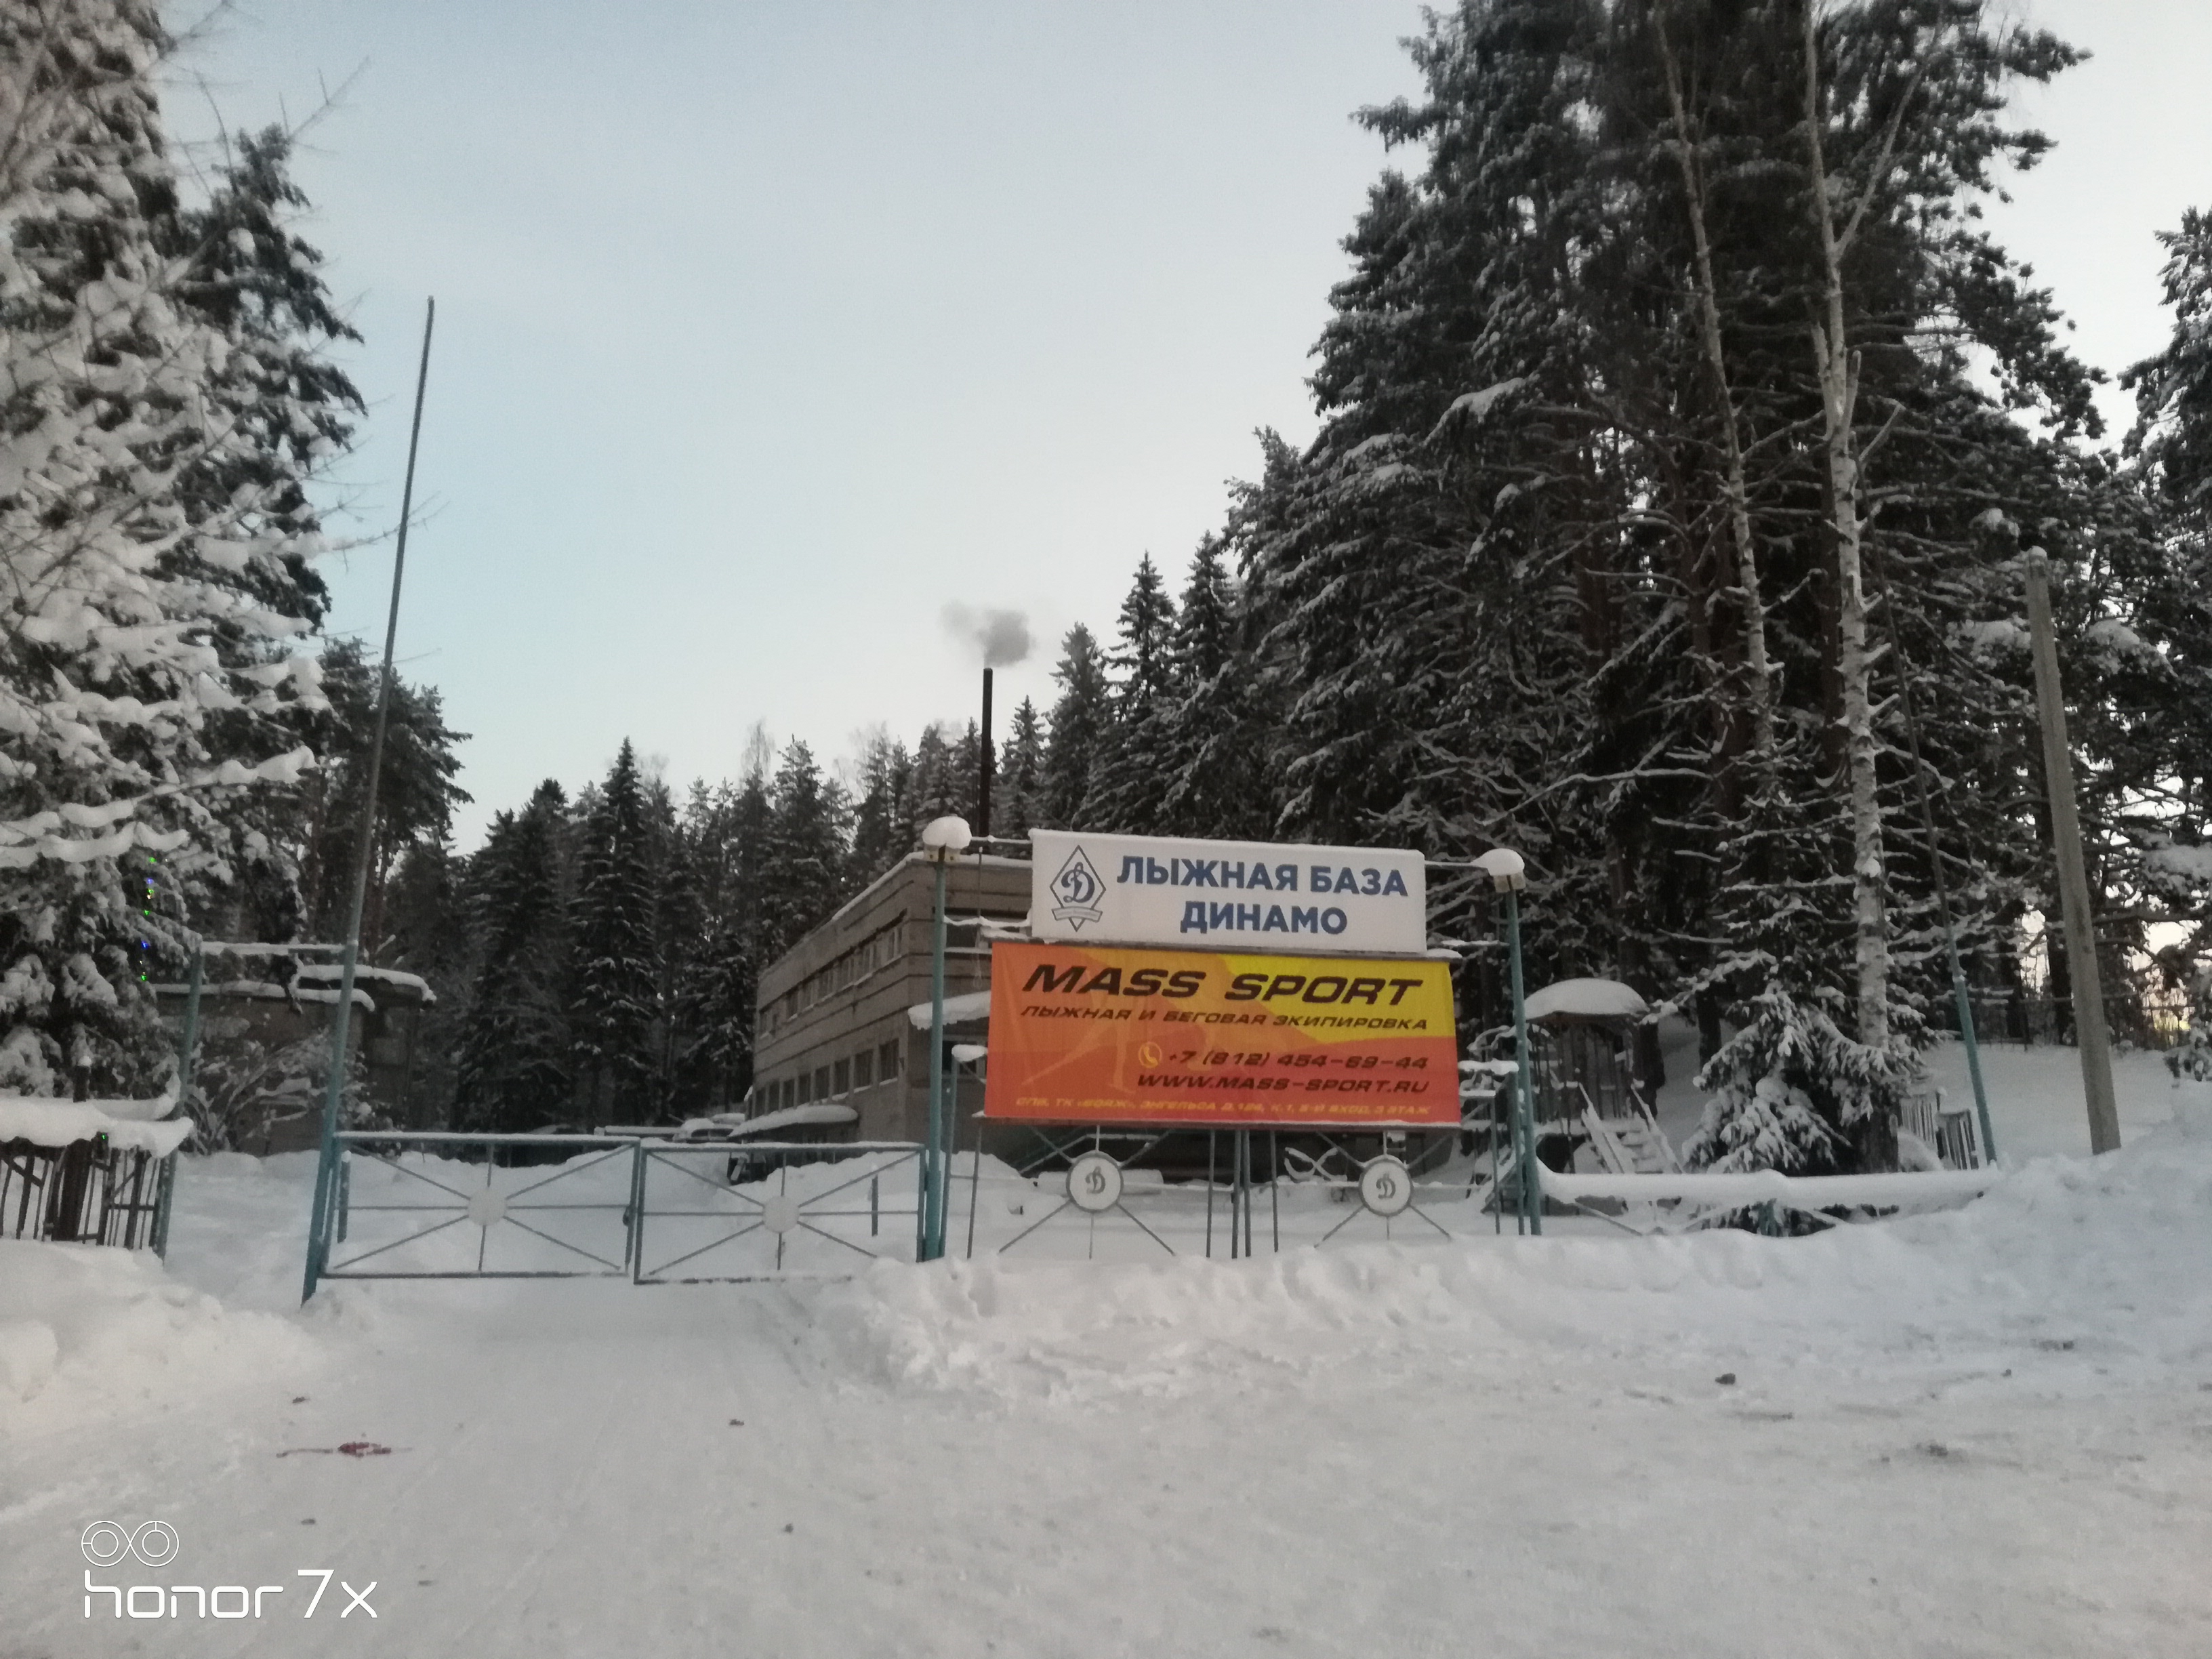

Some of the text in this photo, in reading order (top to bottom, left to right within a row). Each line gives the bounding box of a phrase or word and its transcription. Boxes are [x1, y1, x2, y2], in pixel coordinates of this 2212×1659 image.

[1117, 855, 1408, 897] ЛЫЖНАЯ БАЗА
[1180, 901, 1348, 935] ДИНАМО
[1022, 964, 1424, 1006] MASS SPORT
[1021, 1005, 1428, 1030] ЛЫЖНАЯ И БЕГОВАЯ ЭКИПИРОВКА
[1169, 1050, 1197, 1065] +7
[1202, 1050, 1271, 1067] (812)
[1137, 1074, 1429, 1094] WWW.MASS-SPORT.RU
